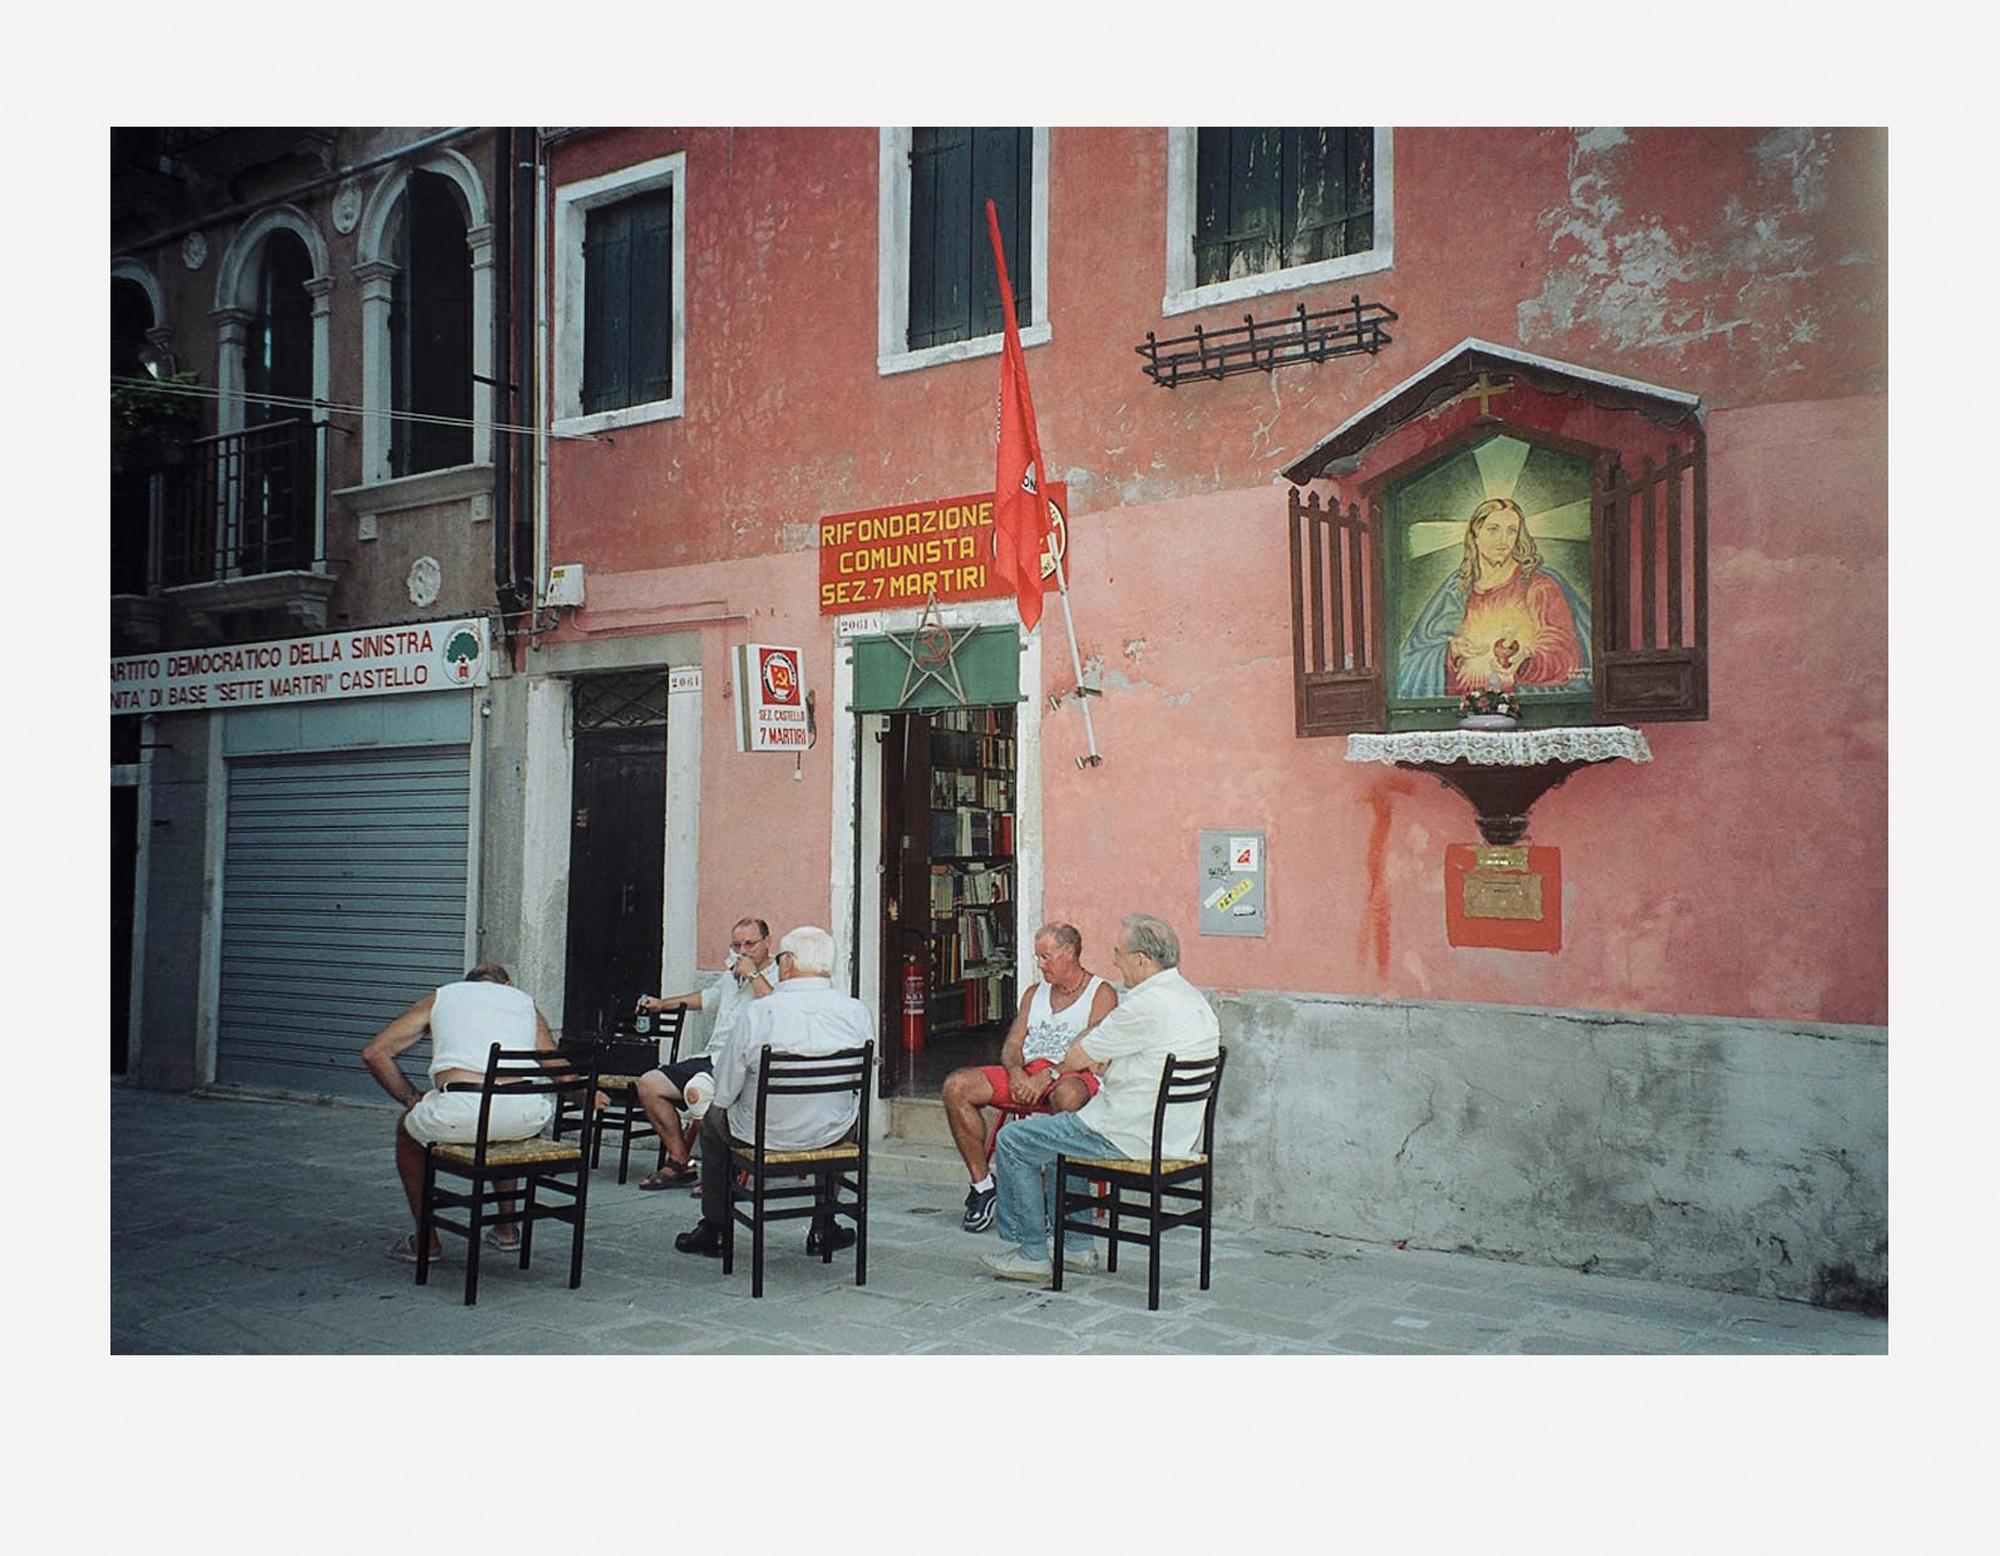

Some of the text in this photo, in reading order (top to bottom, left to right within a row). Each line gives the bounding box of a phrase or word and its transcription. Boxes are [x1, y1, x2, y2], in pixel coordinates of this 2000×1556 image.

[821, 502, 994, 547] RIFONDAZIONE
[838, 536, 976, 575] COMUNISTA
[890, 565, 987, 598] MARTIRI
[167, 647, 282, 678] DEMOCRATICO
[289, 639, 343, 667] DELLA
[352, 630, 434, 660] SINISTRA
[150, 688, 163, 707] DI
[168, 684, 208, 706] BASE
[340, 665, 428, 692] CASTELLO
[769, 727, 807, 745] MARTIRI
